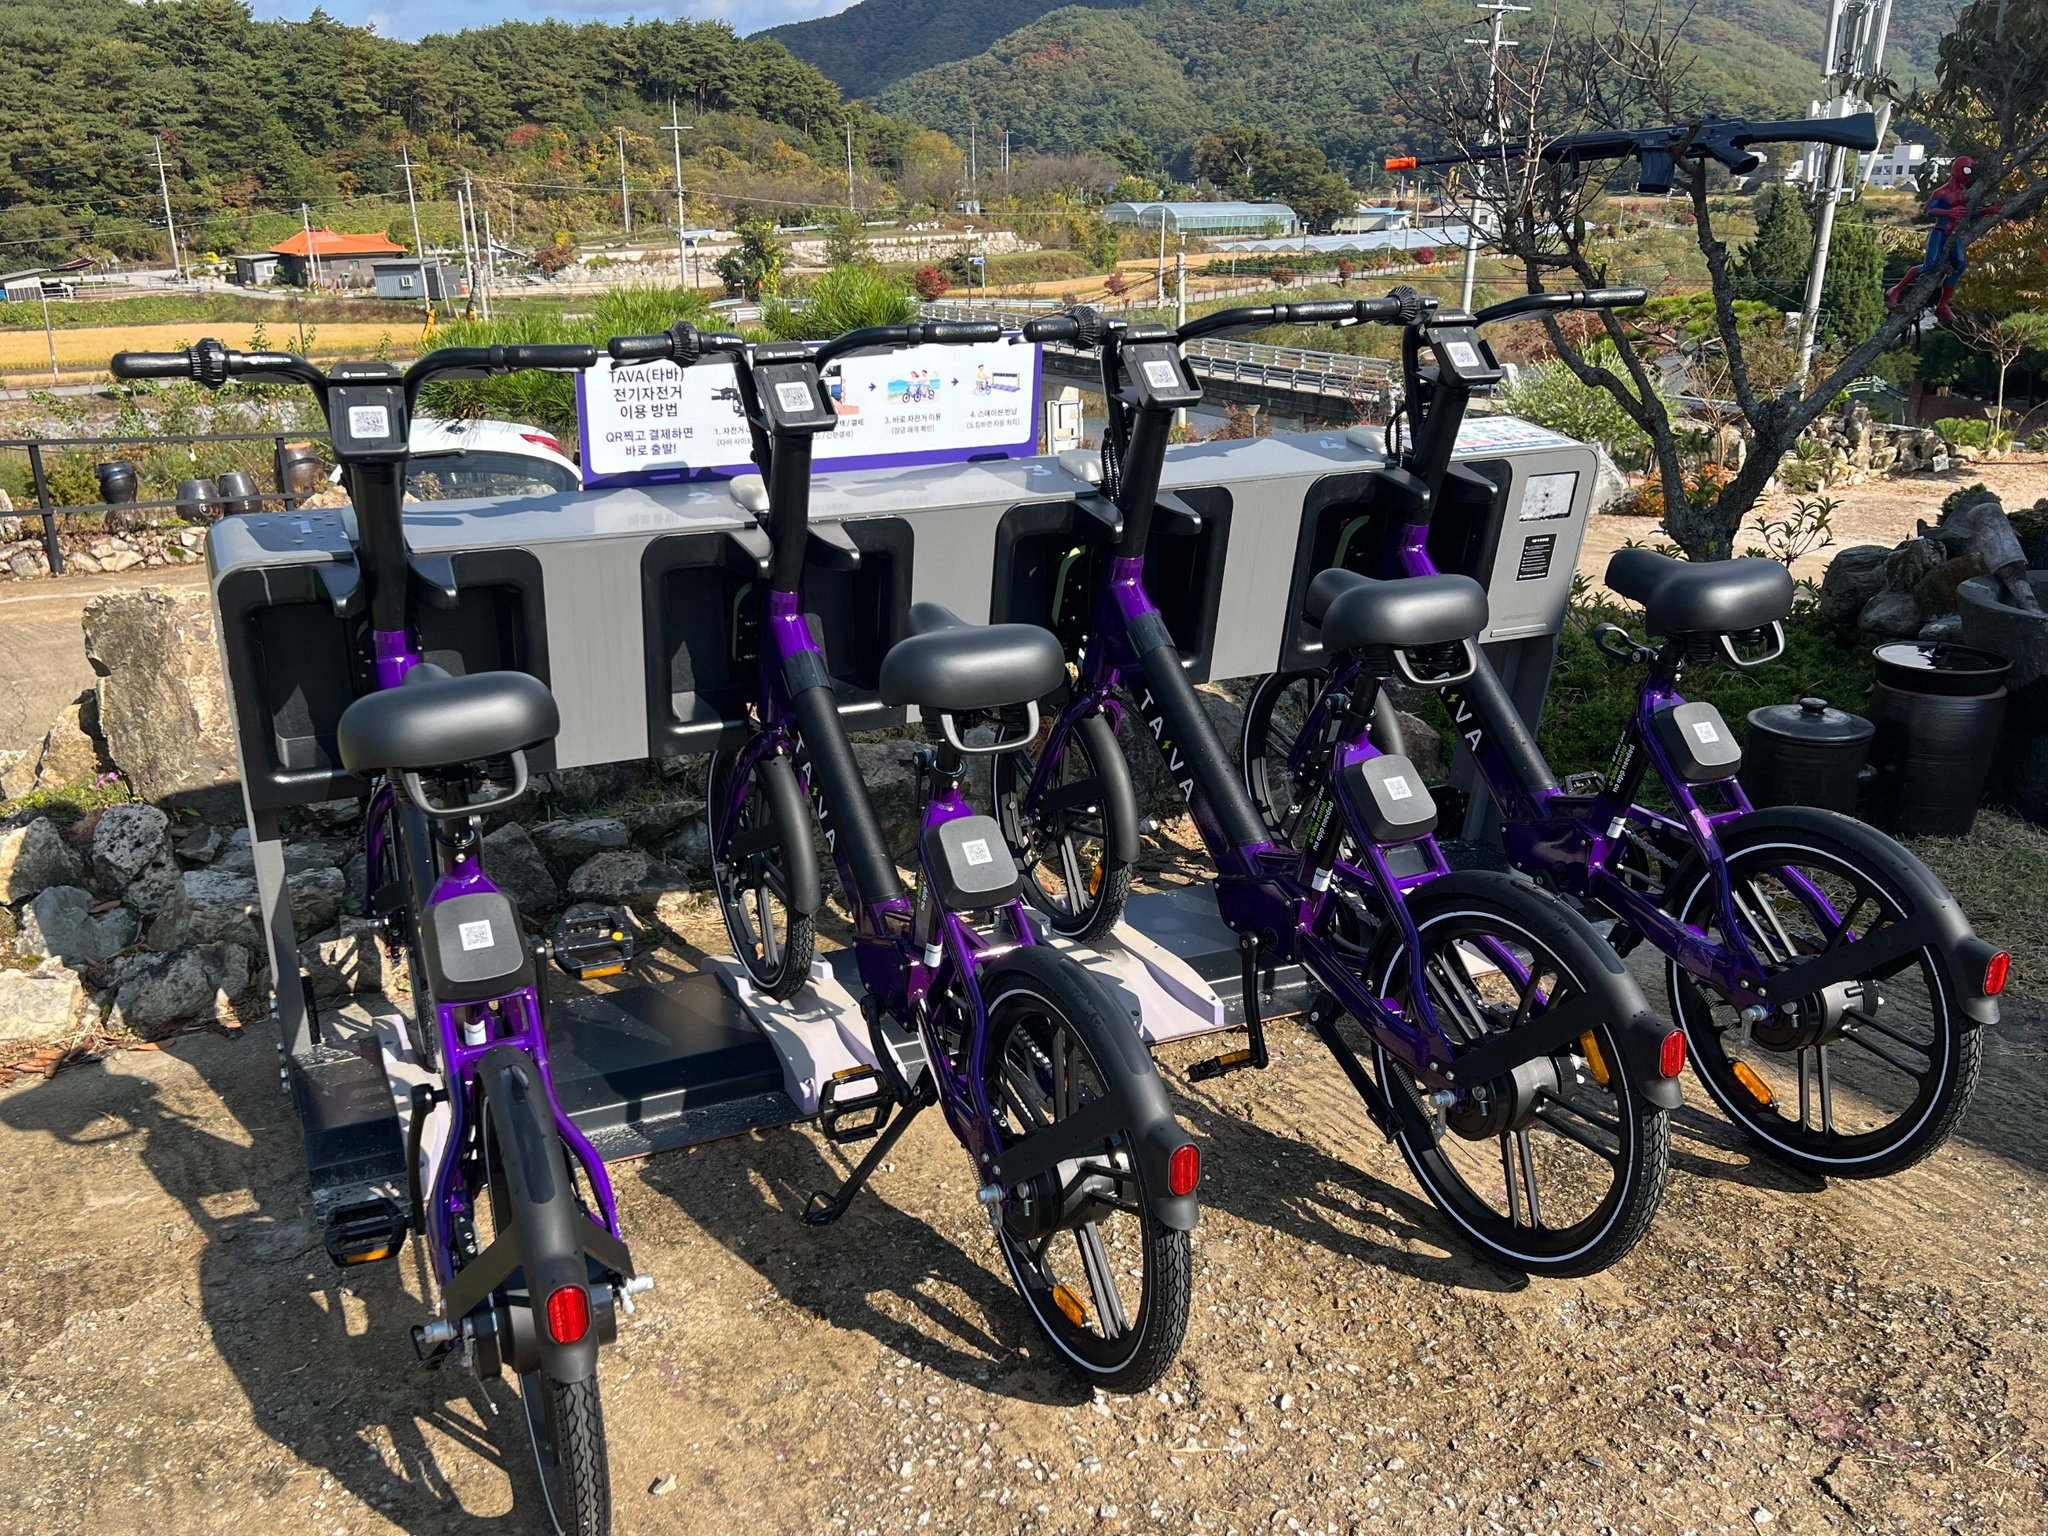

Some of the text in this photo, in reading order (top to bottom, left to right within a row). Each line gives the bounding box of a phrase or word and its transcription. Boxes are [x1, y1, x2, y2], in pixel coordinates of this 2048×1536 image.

[608, 367, 684, 384] TAVA(타바)
[613, 385, 682, 402] 전기자전거
[620, 402, 678, 419] 이용 방법
[892, 415, 906, 424] 바로
[907, 413, 928, 423] 자전거
[928, 412, 941, 421] 이용
[977, 408, 1003, 417] 스테이션
[606, 426, 694, 443] QR찍고 결제하면
[723, 426, 744, 435] 자전거
[625, 442, 677, 457] 바로 출발!
[1141, 688, 1194, 802] TAVA
[1608, 765, 1620, 786] e-bike
[1617, 744, 1628, 766] rental
[1612, 783, 1620, 793] no
[1616, 770, 1626, 784] app
[1621, 743, 1635, 770] needed
[796, 730, 835, 853] TAVA
[1309, 822, 1320, 843] e-bike
[1316, 800, 1327, 823] rental
[1312, 841, 1320, 851] no
[1316, 827, 1326, 842] app
[1321, 800, 1334, 828] needed
